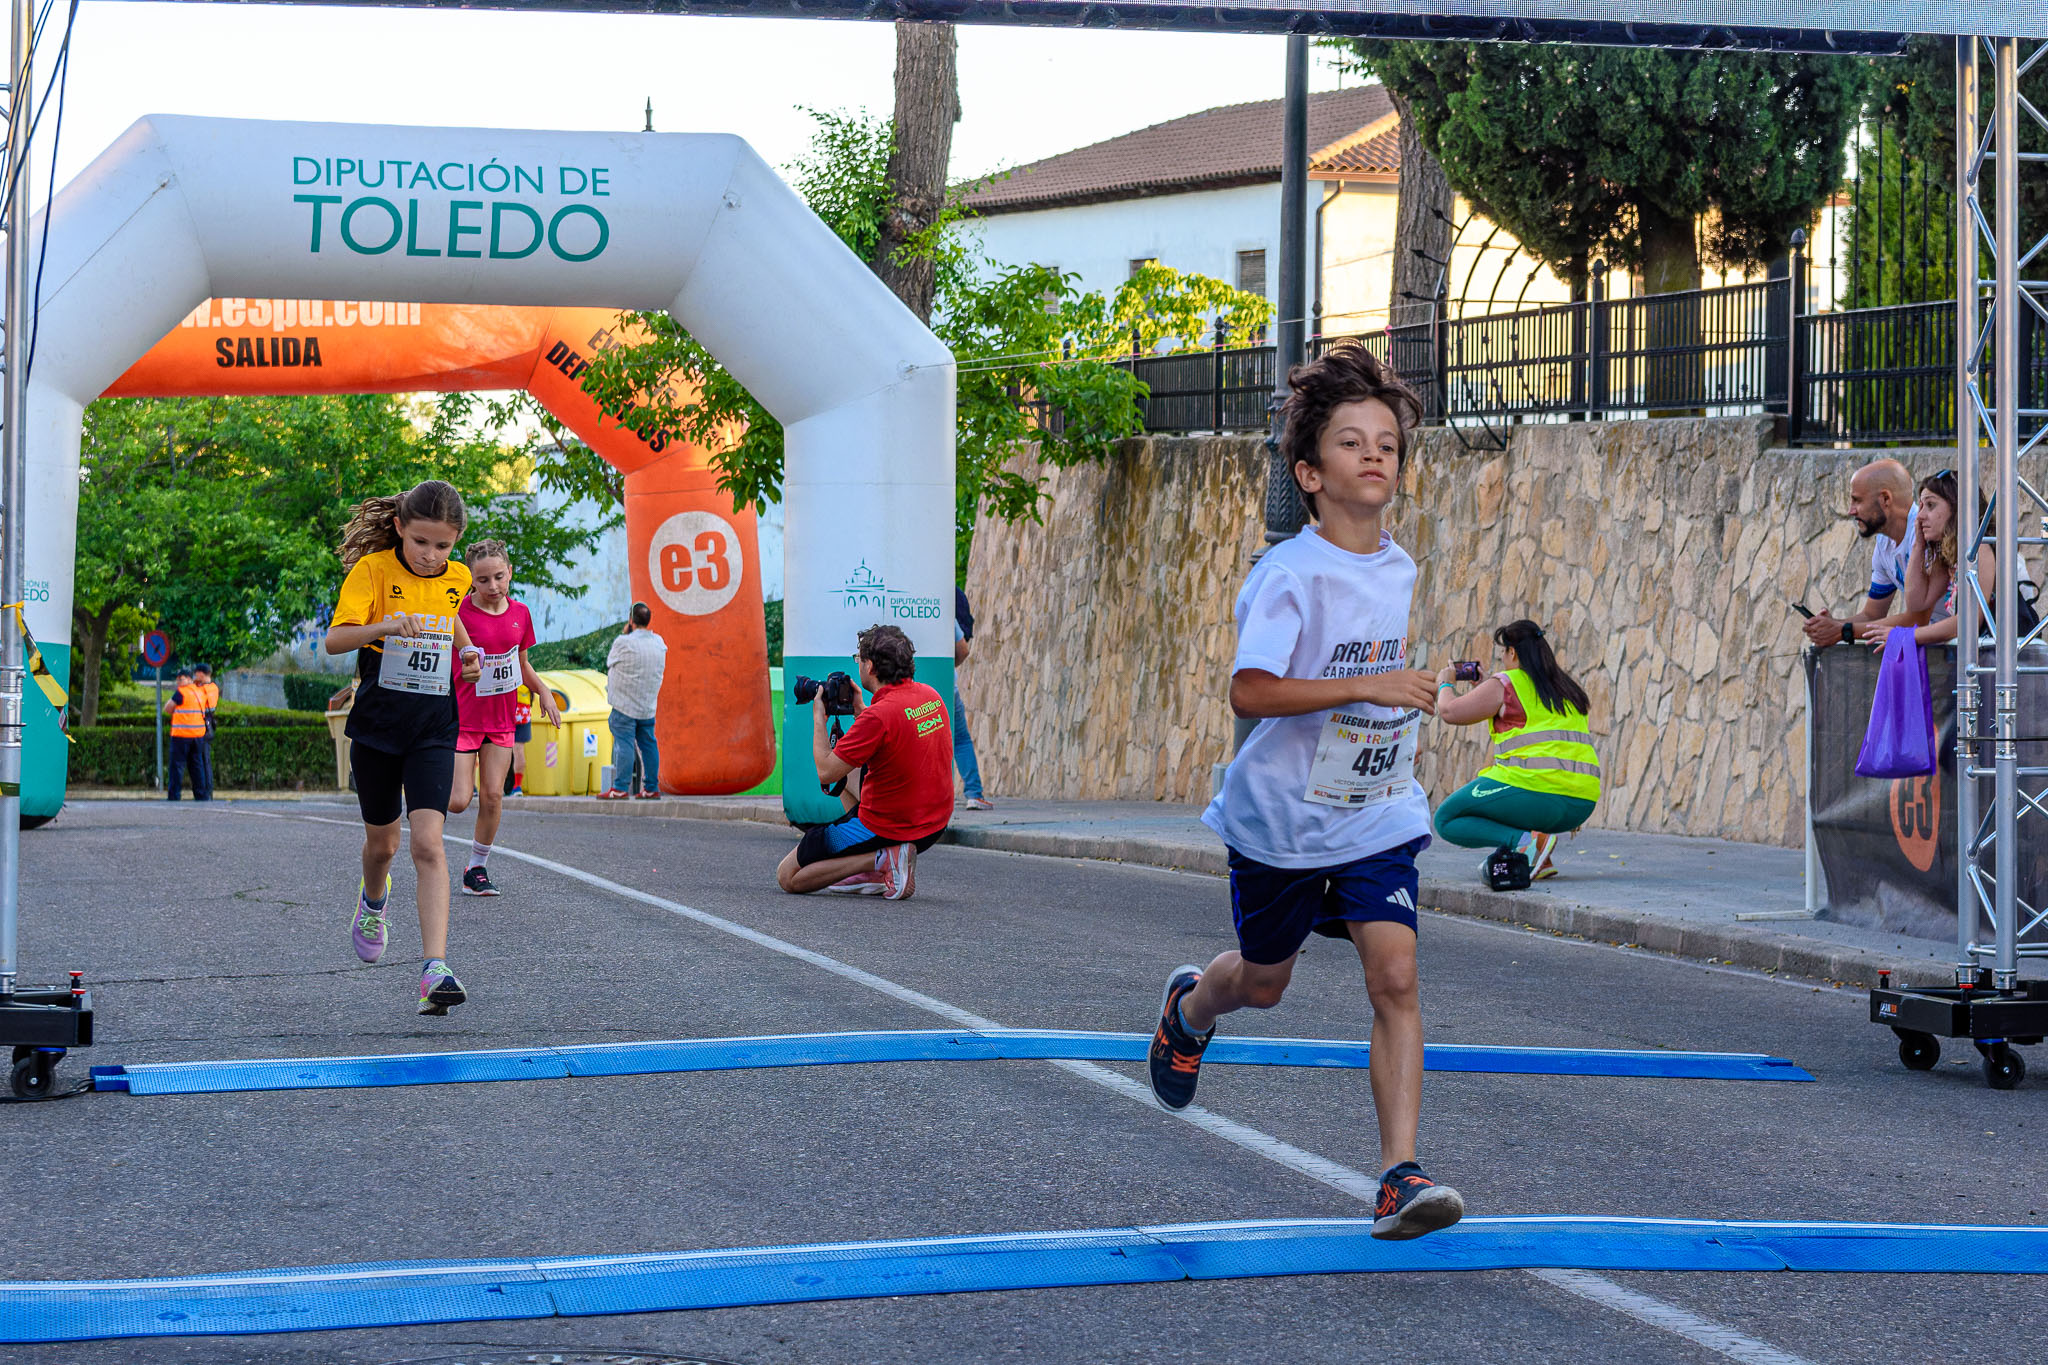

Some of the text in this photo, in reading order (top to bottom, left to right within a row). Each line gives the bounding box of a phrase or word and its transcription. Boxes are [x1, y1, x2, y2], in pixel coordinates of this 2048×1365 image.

[293, 157, 611, 196] DIPUTACIÓN DE
[293, 194, 610, 263] TOLEDO
[215, 336, 323, 369] SALIDA
[660, 531, 731, 593] e3
[890, 597, 941, 606] DIPUTACIÓN DE
[890, 605, 941, 619] TOLEDO
[407, 651, 440, 673] 457
[492, 664, 513, 681] 461
[1330, 712, 1342, 724] XI
[1341, 714, 1371, 729] LEGUA
[1370, 715, 1407, 731] NOCTURNA
[1351, 743, 1400, 777] 454
